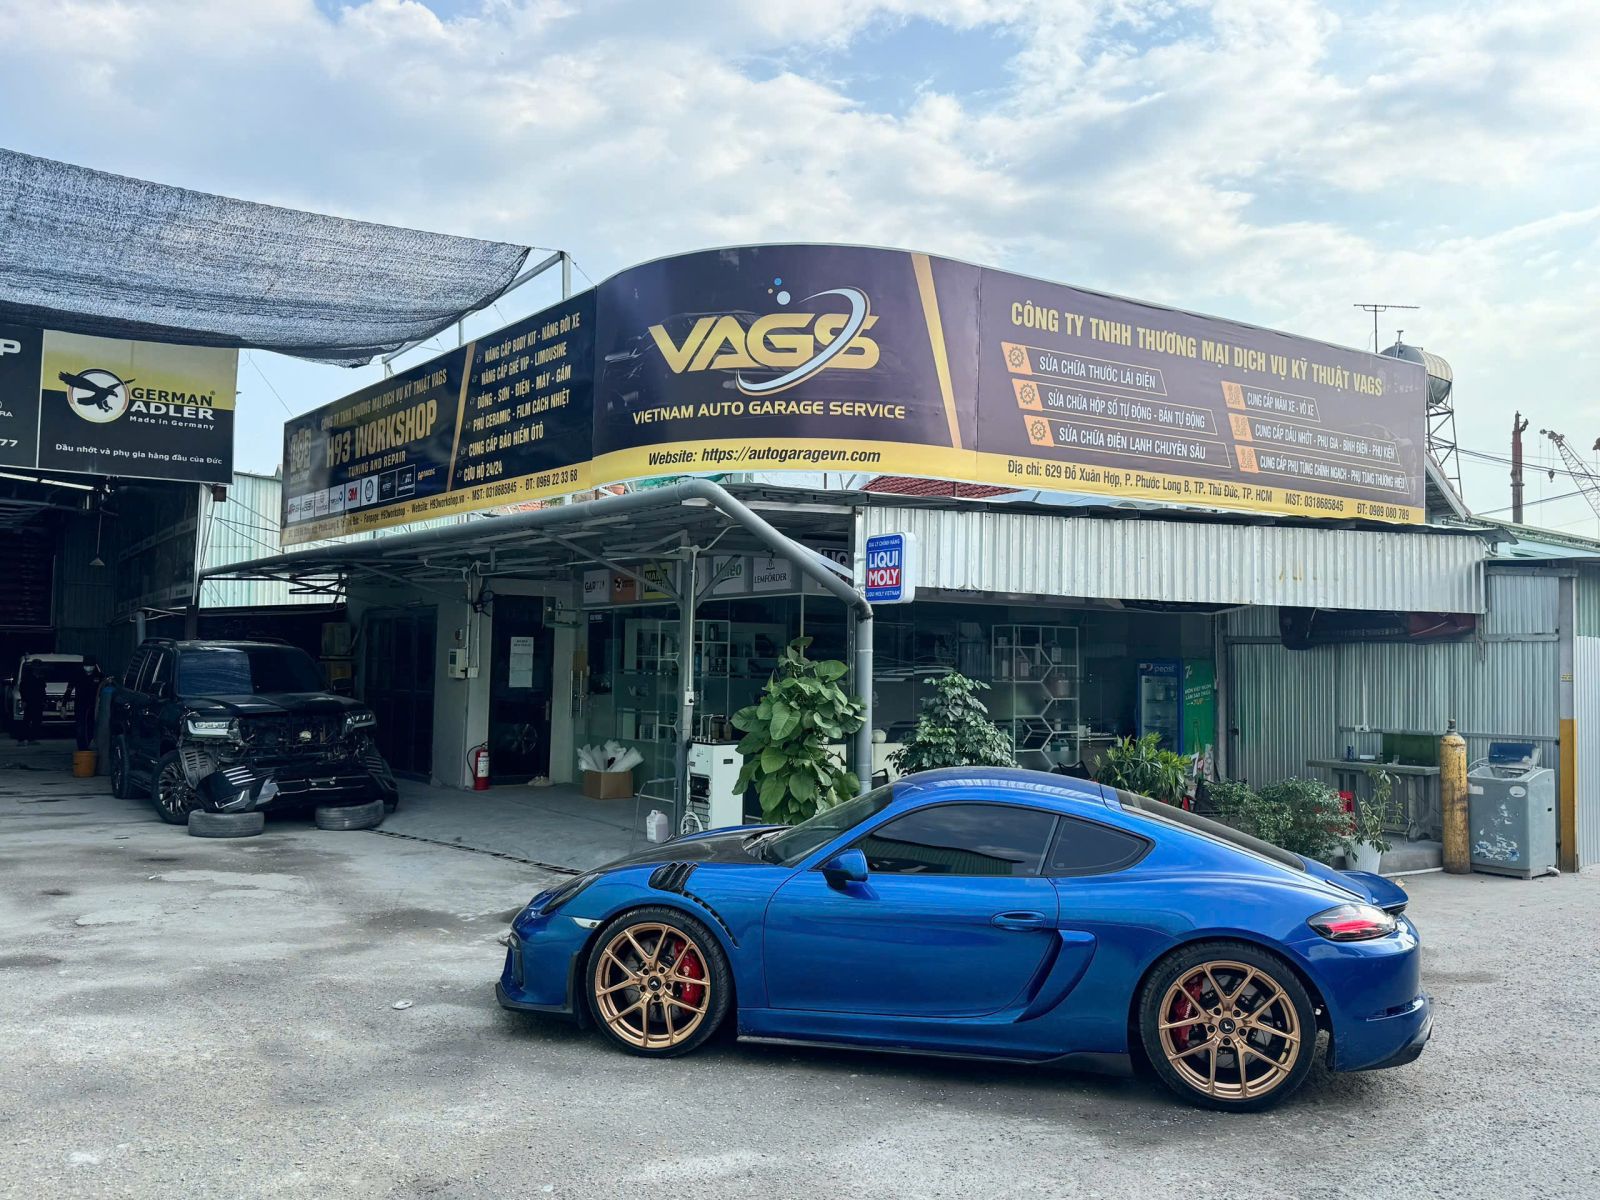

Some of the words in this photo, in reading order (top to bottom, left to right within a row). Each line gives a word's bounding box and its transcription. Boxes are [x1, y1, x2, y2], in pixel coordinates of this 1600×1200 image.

[528, 330, 537, 346] KIT
[572, 312, 580, 330] XE
[648, 313, 880, 374] VAGS
[1011, 300, 1059, 333] CÔNG
[1064, 312, 1084, 337] TY
[1089, 317, 1132, 346] TNHH
[1137, 327, 1197, 359] THƯƠNG
[1202, 340, 1229, 368] MẠI
[1234, 346, 1266, 373] DỊCH
[1270, 354, 1287, 381] VỤ
[1291, 357, 1308, 381] KỸ
[1312, 365, 1350, 392] THUẬT
[1353, 372, 1383, 397] VAGS
[520, 356, 530, 372] VIP
[534, 341, 567, 366] LIMOUSINE
[432, 368, 447, 388] VAGS
[1039, 353, 1059, 372] SỬA
[1061, 359, 1086, 377] CHỮA
[1088, 364, 1118, 382] THƯỚC
[1120, 369, 1134, 385] LÁI
[1136, 372, 1156, 391] ĐIỆN
[131, 387, 213, 408] GERMAN
[1048, 388, 1064, 408] SỬA
[1066, 394, 1088, 410] CHỮA
[1090, 398, 1106, 416] HỘP
[1108, 398, 1118, 414] SỐ
[1132, 404, 1152, 422] ĐỘNG
[1158, 408, 1173, 424] BÁN
[1186, 412, 1206, 428] ĐỘNG
[1247, 392, 1262, 407] CUNG
[1288, 400, 1295, 412] XE
[1308, 404, 1314, 416] XE
[130, 401, 215, 420] ADLER
[486, 408, 511, 428] CERAMIC
[516, 402, 531, 419] FILM
[532, 396, 548, 414] CÁCH
[633, 403, 694, 424] VIETNAM
[697, 401, 744, 418] AUTO
[748, 400, 824, 415] GARAGE
[829, 401, 905, 419] SERVICE
[130, 416, 156, 424] Made
[172, 420, 214, 431] Germany
[326, 431, 351, 468] H93
[355, 400, 438, 459] WORKSHOP
[468, 440, 485, 457] CUNG
[1059, 424, 1078, 443] SỬA
[1080, 429, 1105, 446] CHỮA
[1107, 434, 1127, 452] ĐIỆN
[1130, 438, 1152, 454] LẠNH
[1155, 440, 1188, 457] CHUYÊN
[1190, 442, 1206, 460] SÂU
[1256, 424, 1271, 438] CUNG
[1330, 436, 1339, 450] GIA
[56, 443, 74, 452] Dầu
[76, 444, 98, 454] nhớt
[100, 447, 111, 456] và
[113, 449, 130, 458] phụ
[132, 450, 146, 460] gia
[148, 452, 170, 462] hàng
[172, 452, 188, 462] đầu
[190, 455, 204, 464] của
[206, 456, 222, 465] Đức
[348, 464, 369, 478] TUNING
[370, 456, 382, 471] AND
[383, 450, 406, 467] REPAIR
[648, 450, 697, 466] Website:
[701, 447, 881, 464] https://autogaragevn.com
[1260, 455, 1276, 470] CUNG
[476, 463, 485, 481] HỘ
[486, 460, 503, 477] 24/24
[348, 487, 358, 501] 3M
[472, 488, 485, 501] MST:
[526, 478, 536, 491] ĐT:
[536, 473, 550, 488] 0969
[552, 472, 560, 486] 22
[560, 470, 569, 484] 33
[1008, 460, 1024, 478] Địa
[1045, 464, 1062, 479] 629
[1064, 464, 1076, 481] Đỗ
[1080, 468, 1101, 484] Xuân
[1104, 471, 1122, 488] Hợp,
[1125, 473, 1133, 487] P.
[1136, 474, 1160, 490] Phước
[1162, 477, 1182, 495] Long
[1184, 480, 1192, 494] B,
[1194, 481, 1206, 495] TP.
[1208, 482, 1222, 496] Thủ
[1242, 487, 1253, 501] TP.
[1256, 489, 1272, 502] HCM
[1285, 492, 1302, 506] MST:
[1357, 502, 1368, 516] ĐT:
[1398, 508, 1410, 520] 789
[869, 550, 899, 569] LIQUI
[868, 568, 900, 586] MOLY
